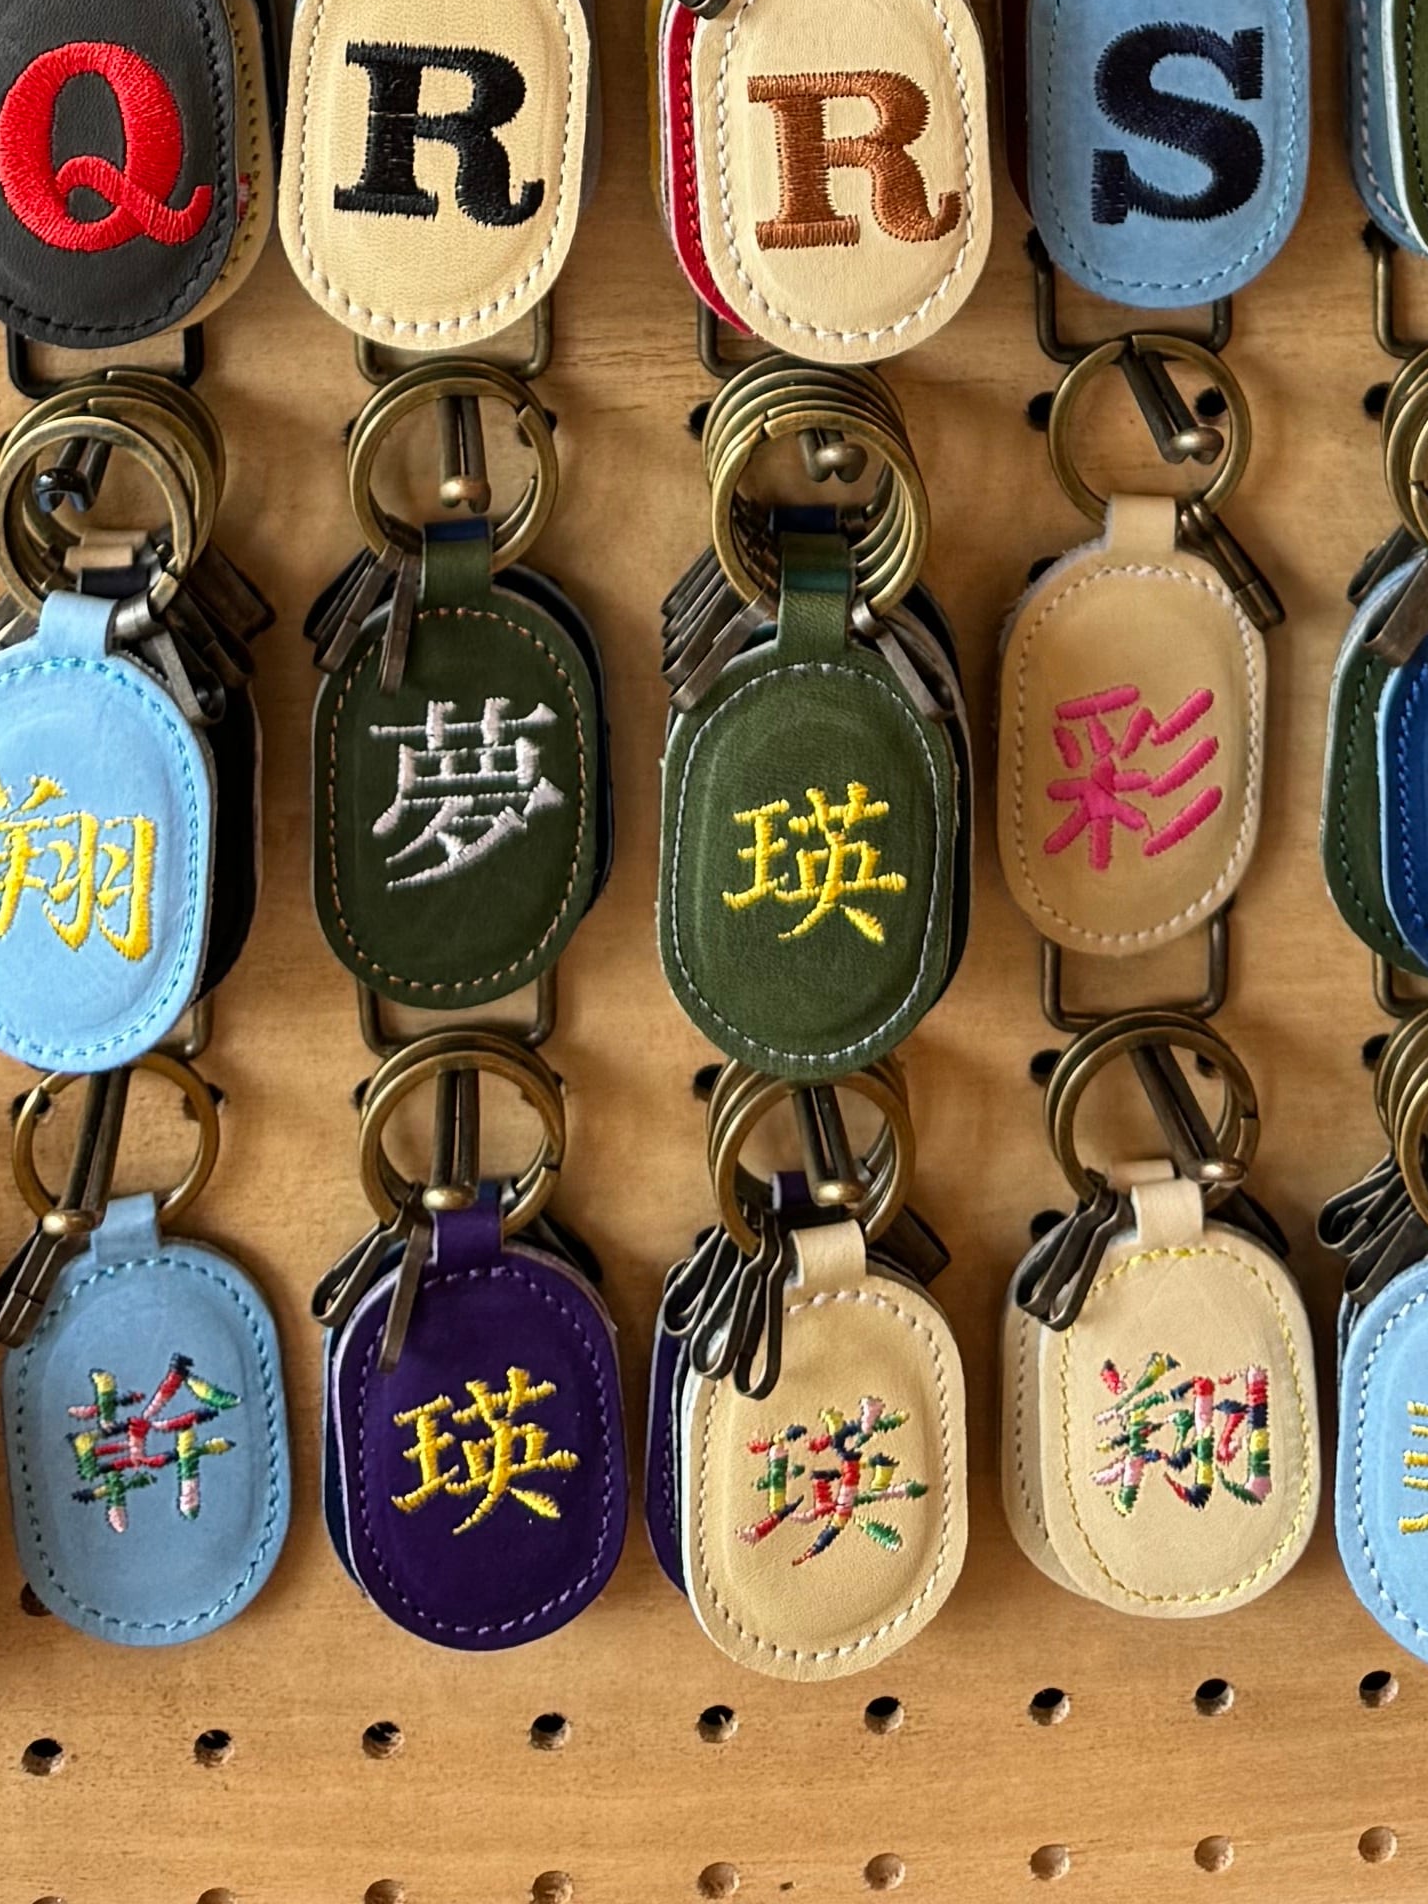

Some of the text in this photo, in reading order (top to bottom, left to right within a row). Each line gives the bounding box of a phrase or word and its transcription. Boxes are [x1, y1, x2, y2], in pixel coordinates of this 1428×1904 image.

[332, 40, 545, 227] R
[745, 70, 962, 250] R
[1090, 21, 1268, 225] S
[369, 695, 567, 893] 夢
[722, 783, 907, 945] 瑛
[1043, 683, 1224, 872] 彩
[390, 1367, 579, 1536] 瑛
[735, 1396, 928, 1568] 瑛
[1090, 1353, 1275, 1518] 翔
